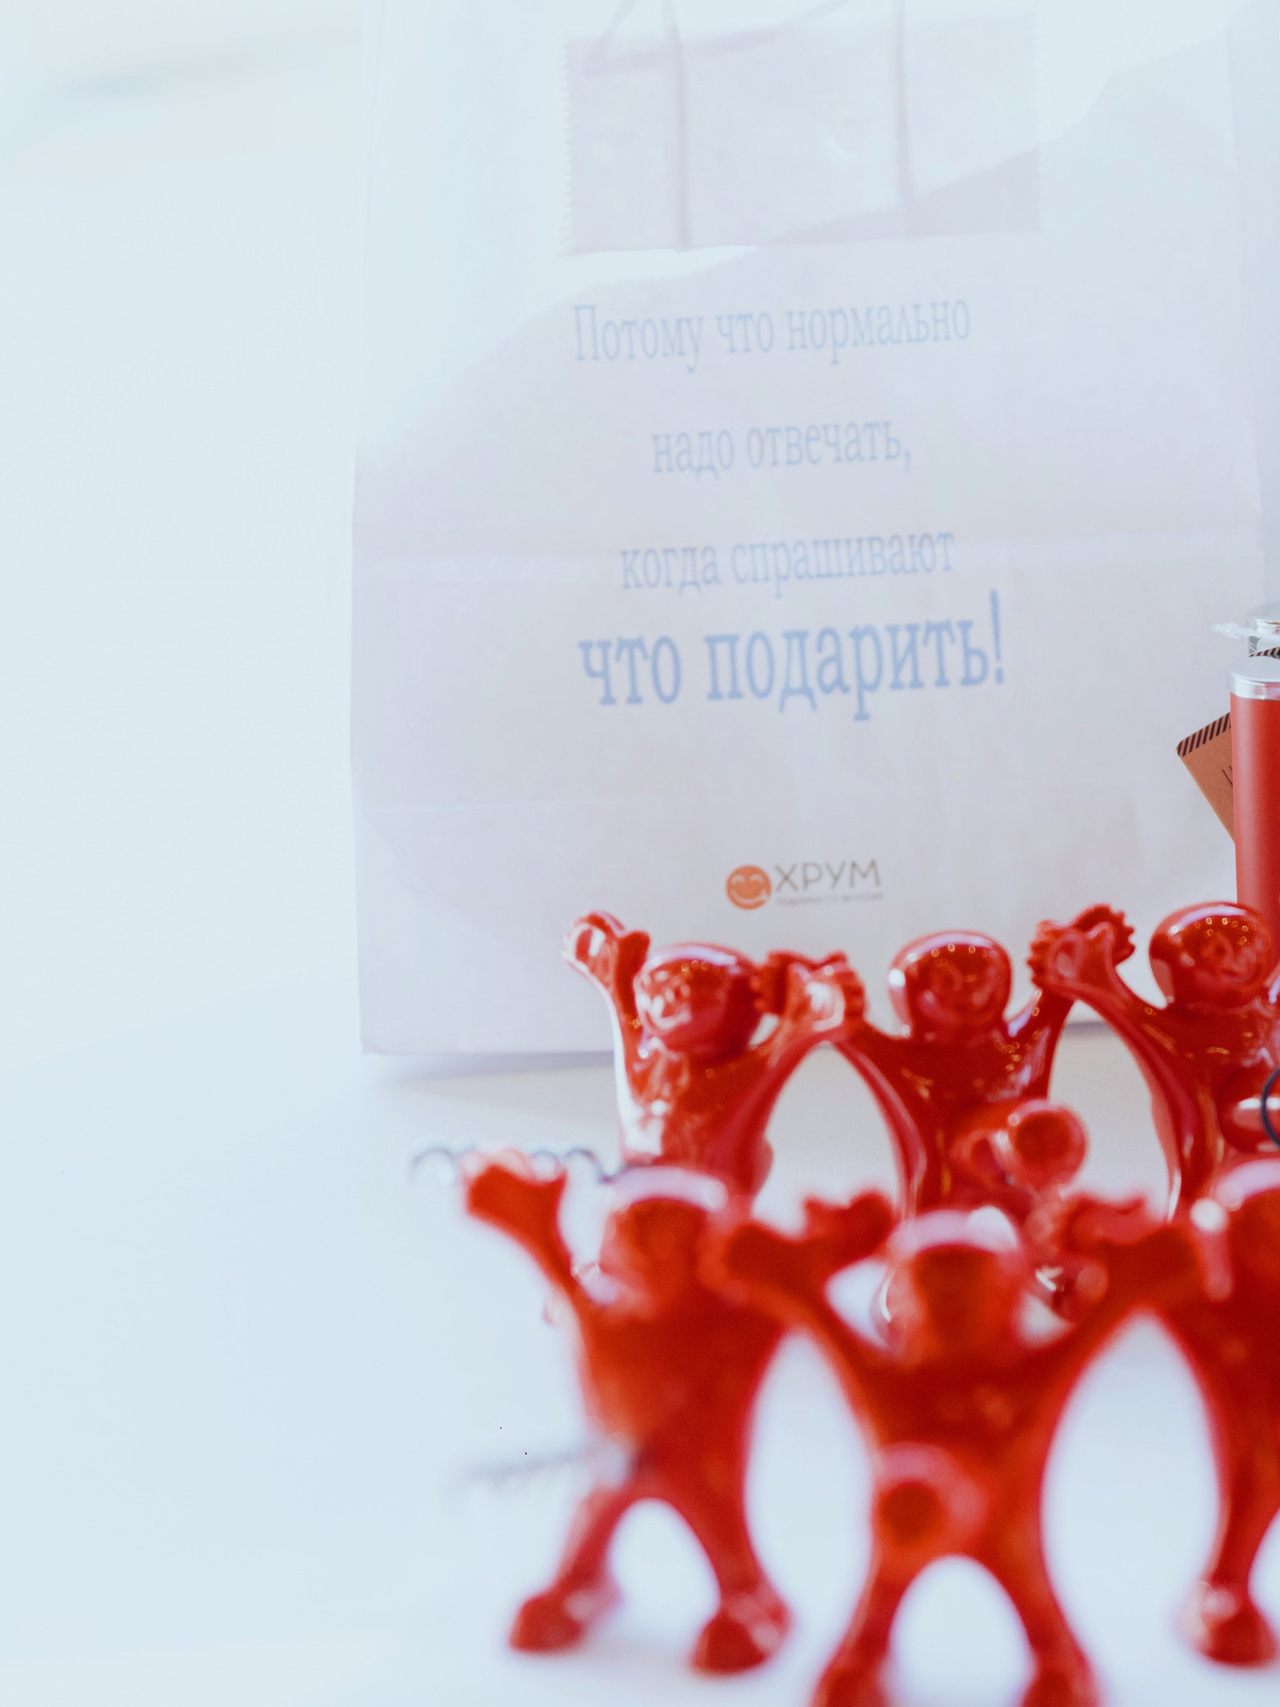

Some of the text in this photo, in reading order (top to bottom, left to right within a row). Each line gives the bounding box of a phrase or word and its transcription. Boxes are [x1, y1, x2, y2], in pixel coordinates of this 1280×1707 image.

[573, 299, 971, 373] Потому что нормально
[652, 420, 911, 479] надо отвечать,
[620, 531, 955, 598] когда спрашивают
[578, 589, 1004, 722] что подарить!
[774, 859, 880, 892] ХРУМ
